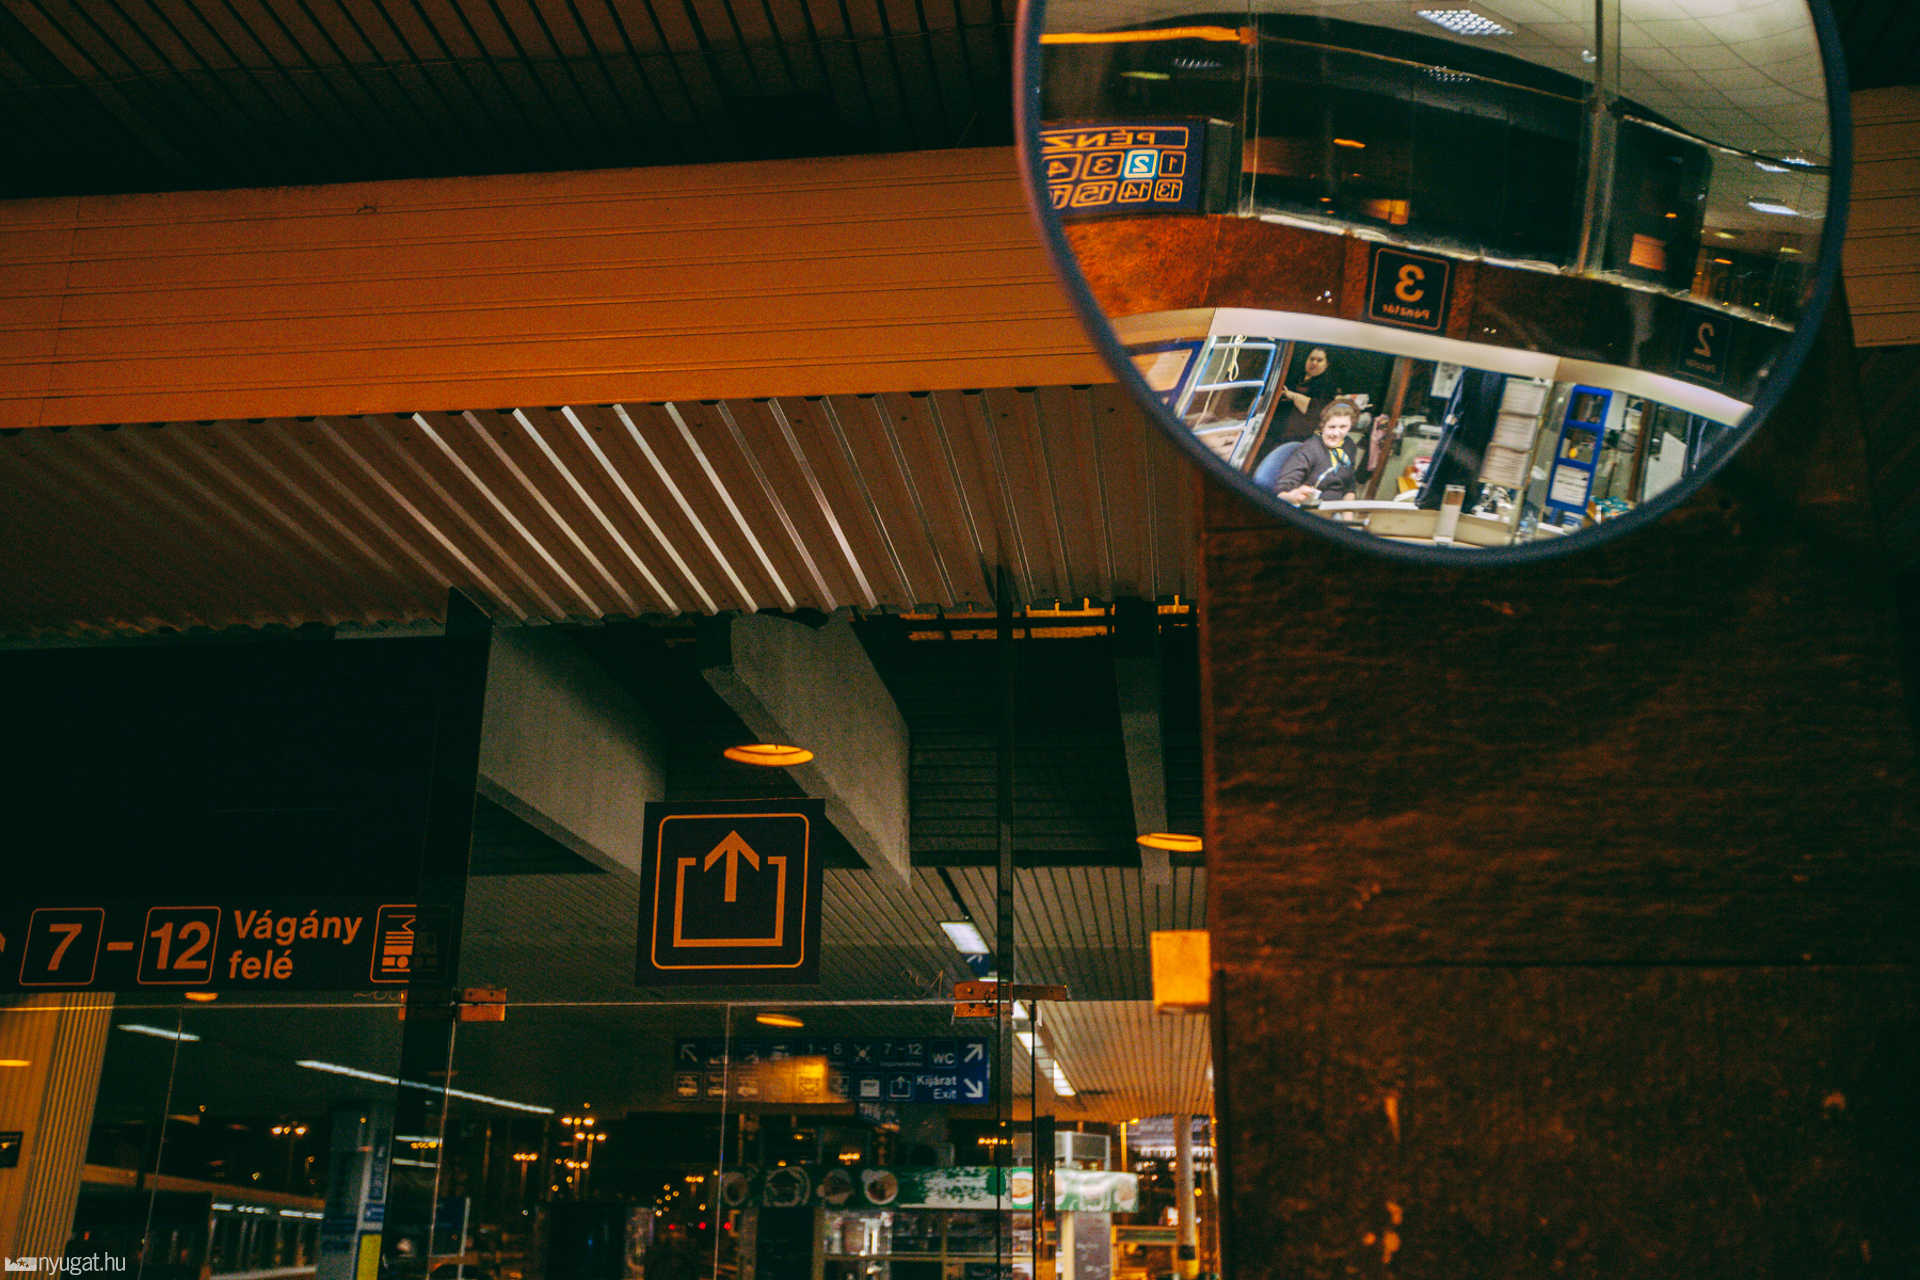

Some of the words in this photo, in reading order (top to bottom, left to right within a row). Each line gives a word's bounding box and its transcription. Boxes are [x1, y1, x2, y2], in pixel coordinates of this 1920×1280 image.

[233, 910, 363, 946] Vágány
[47, 923, 83, 971] 7
[150, 920, 212, 971] 12
[228, 950, 294, 980] felé
[933, 1053, 955, 1065] WC
[932, 1088, 958, 1100] Exit
